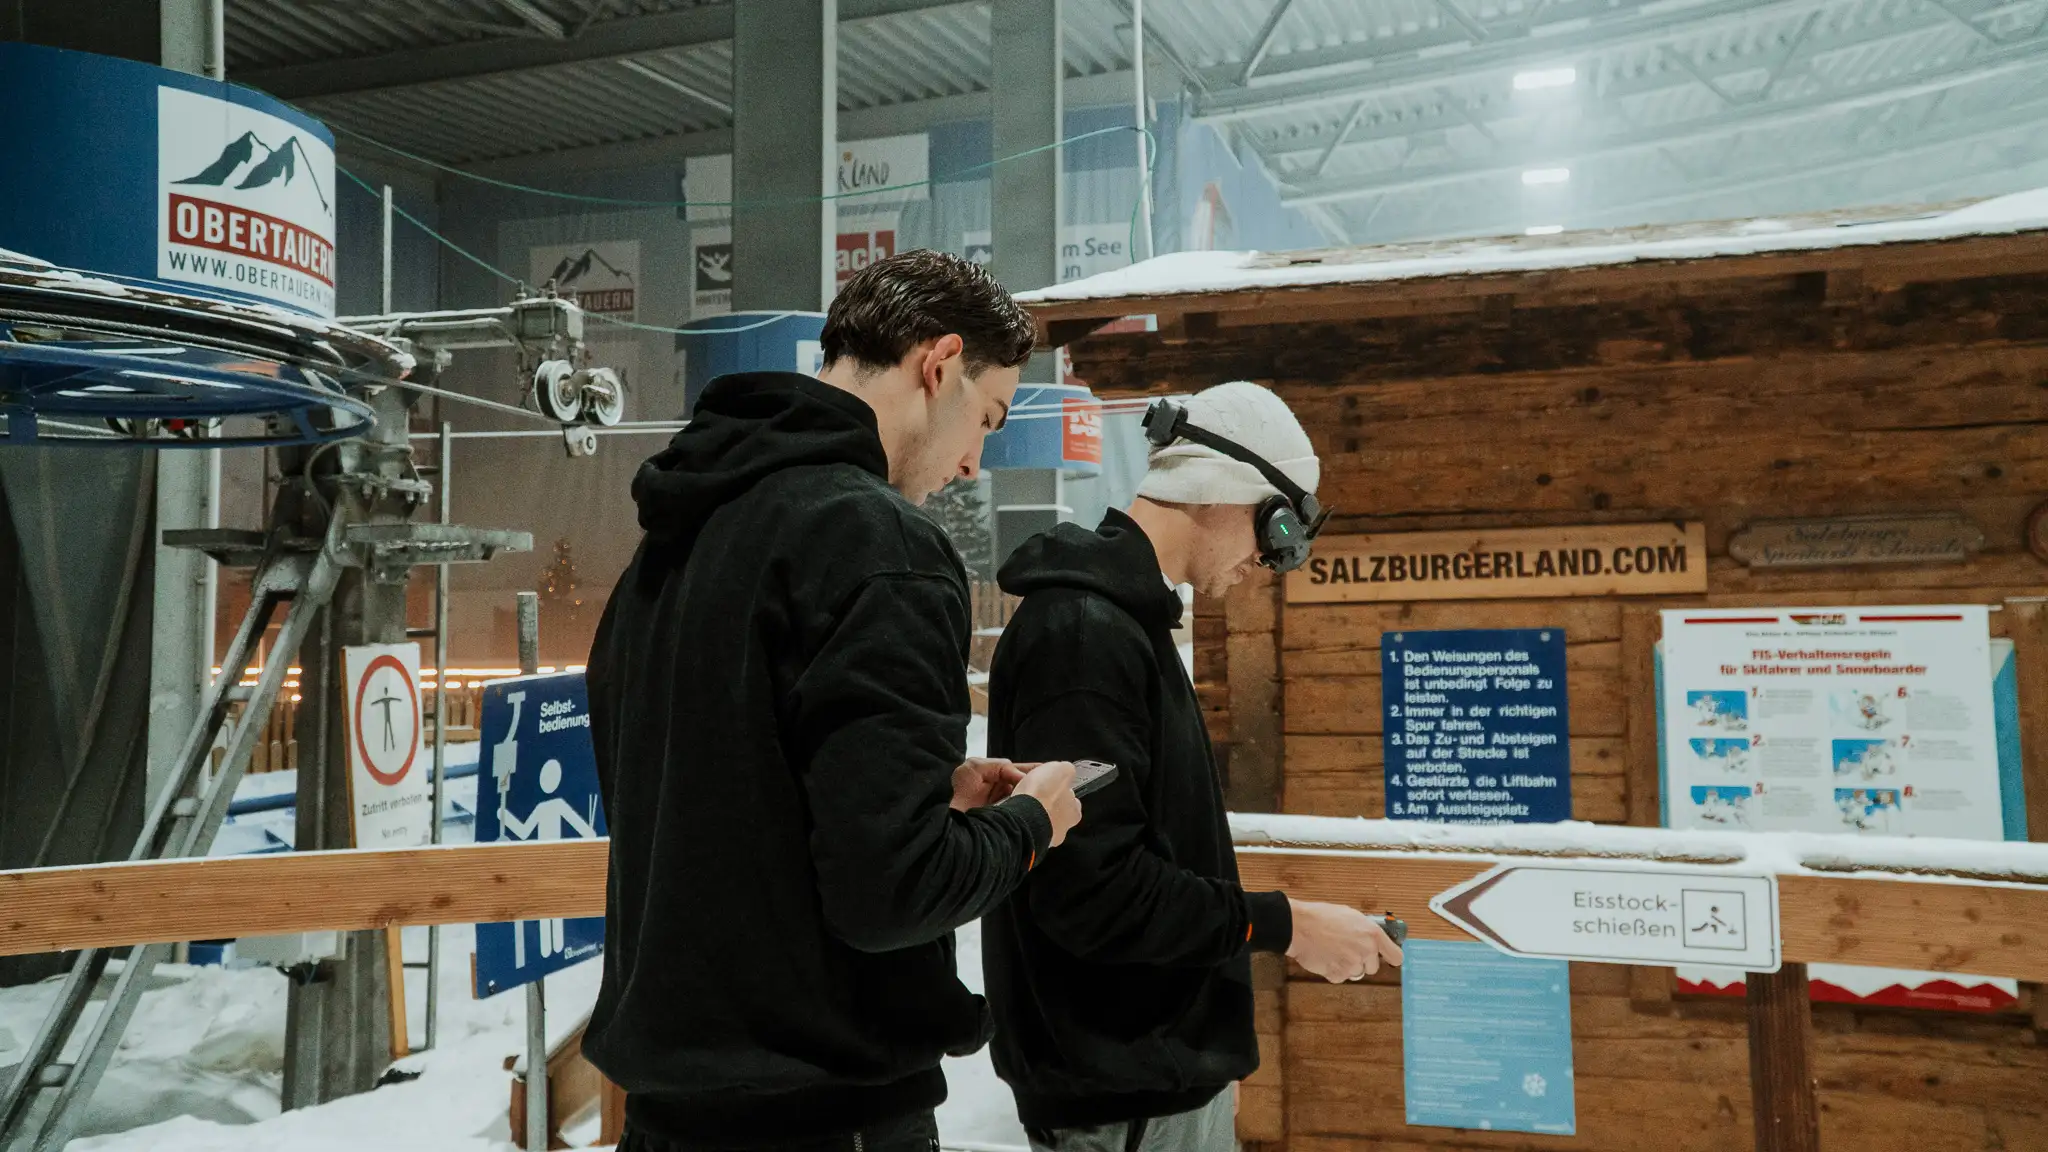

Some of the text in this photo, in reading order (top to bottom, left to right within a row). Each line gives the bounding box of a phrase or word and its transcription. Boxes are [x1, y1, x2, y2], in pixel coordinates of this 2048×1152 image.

[176, 201, 333, 280] OBERTAUERN
[1062, 236, 1122, 257] m See
[1309, 545, 1688, 585] SALZBURGERLAND.COM
[1389, 650, 1529, 664] 1. Den Weisungen des
[1404, 663, 1540, 678] Bedienungspersonals
[1719, 664, 1928, 676] für Skifahrer und Snowboarder
[1404, 677, 1553, 691] ist unbedingt Folge zu
[1404, 692, 1449, 703] leisten.
[540, 698, 577, 718] Selbst-
[1390, 705, 1557, 719] 2. Immer in der richtigen
[539, 713, 591, 734] bedienung
[1405, 719, 1485, 733] Spur fahren.
[1391, 734, 1403, 745] 3.
[1405, 734, 1430, 745] Das
[1491, 733, 1557, 747] Absteigen
[1405, 747, 1530, 759] auf der Strecke ist
[1390, 775, 1557, 788] 4. Gestürzte die Liftbahn
[1407, 789, 1445, 801] sofort
[361, 793, 422, 817] Zutritt verboten
[1393, 803, 1530, 817] 5. Am Aussteigeplatz
[1573, 891, 1679, 911] Eisstock-
[1573, 918, 1676, 937] schießen
